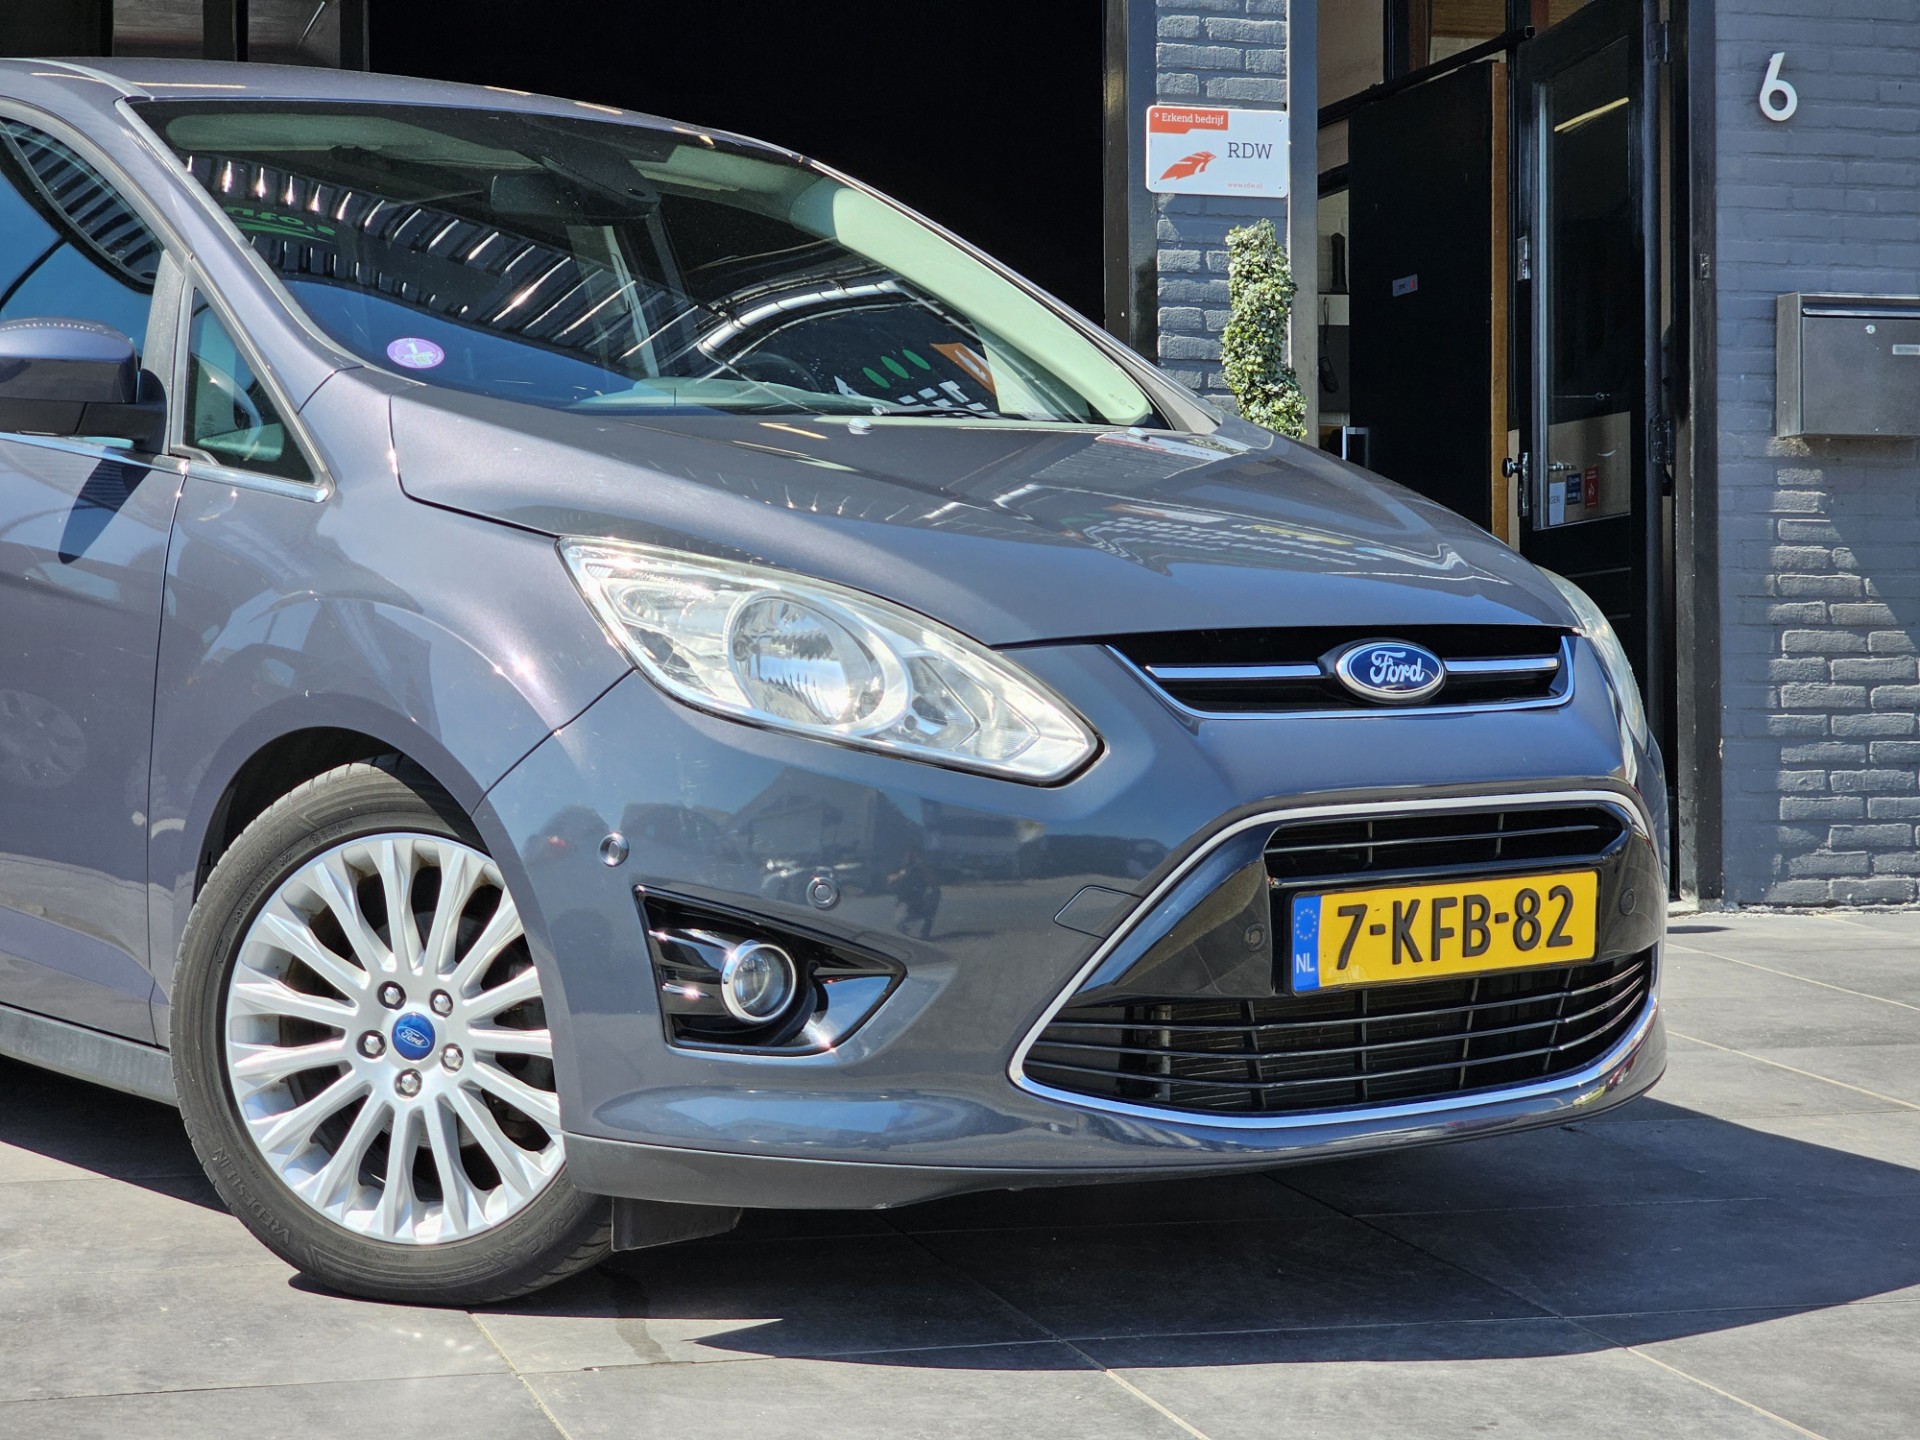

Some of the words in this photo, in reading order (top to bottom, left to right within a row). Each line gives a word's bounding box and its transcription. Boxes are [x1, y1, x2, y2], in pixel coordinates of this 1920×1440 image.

[1759, 51, 1798, 121] 6
[1161, 112, 1193, 123] Erkend
[1195, 114, 1224, 126] bedrijf
[1228, 142, 1273, 159] RDW
[1369, 650, 1425, 684] Ford
[1336, 884, 1574, 970] 7-KFB-82
[1296, 953, 1315, 974] NL
[401, 1028, 425, 1046] Ford
